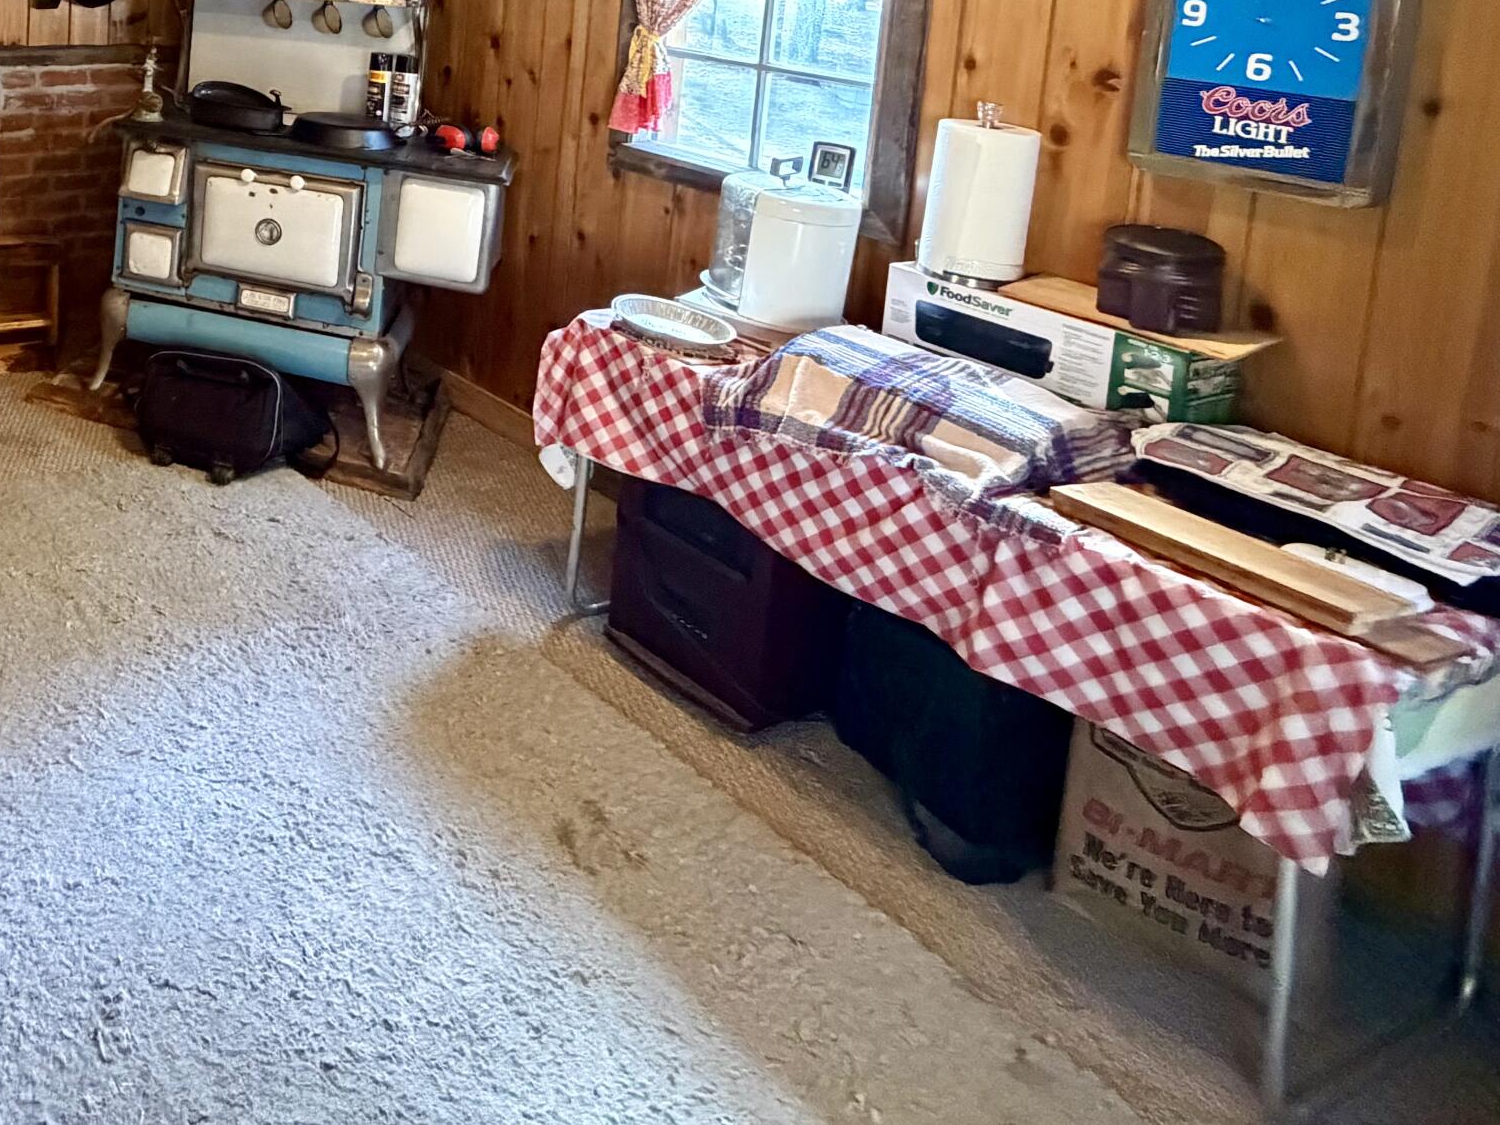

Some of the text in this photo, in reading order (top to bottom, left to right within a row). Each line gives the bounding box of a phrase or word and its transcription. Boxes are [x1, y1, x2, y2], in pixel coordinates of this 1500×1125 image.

[1181, 0, 1208, 27] 9
[1331, 11, 1360, 42] 3
[1245, 52, 1273, 82] 6
[1200, 85, 1312, 127] Coors
[1211, 115, 1295, 144] LIGHT
[821, 151, 841, 172] 64
[1220, 145, 1263, 158] Silver
[1263, 145, 1311, 159] Bullet
[940, 286, 1013, 316] FoodSaver
